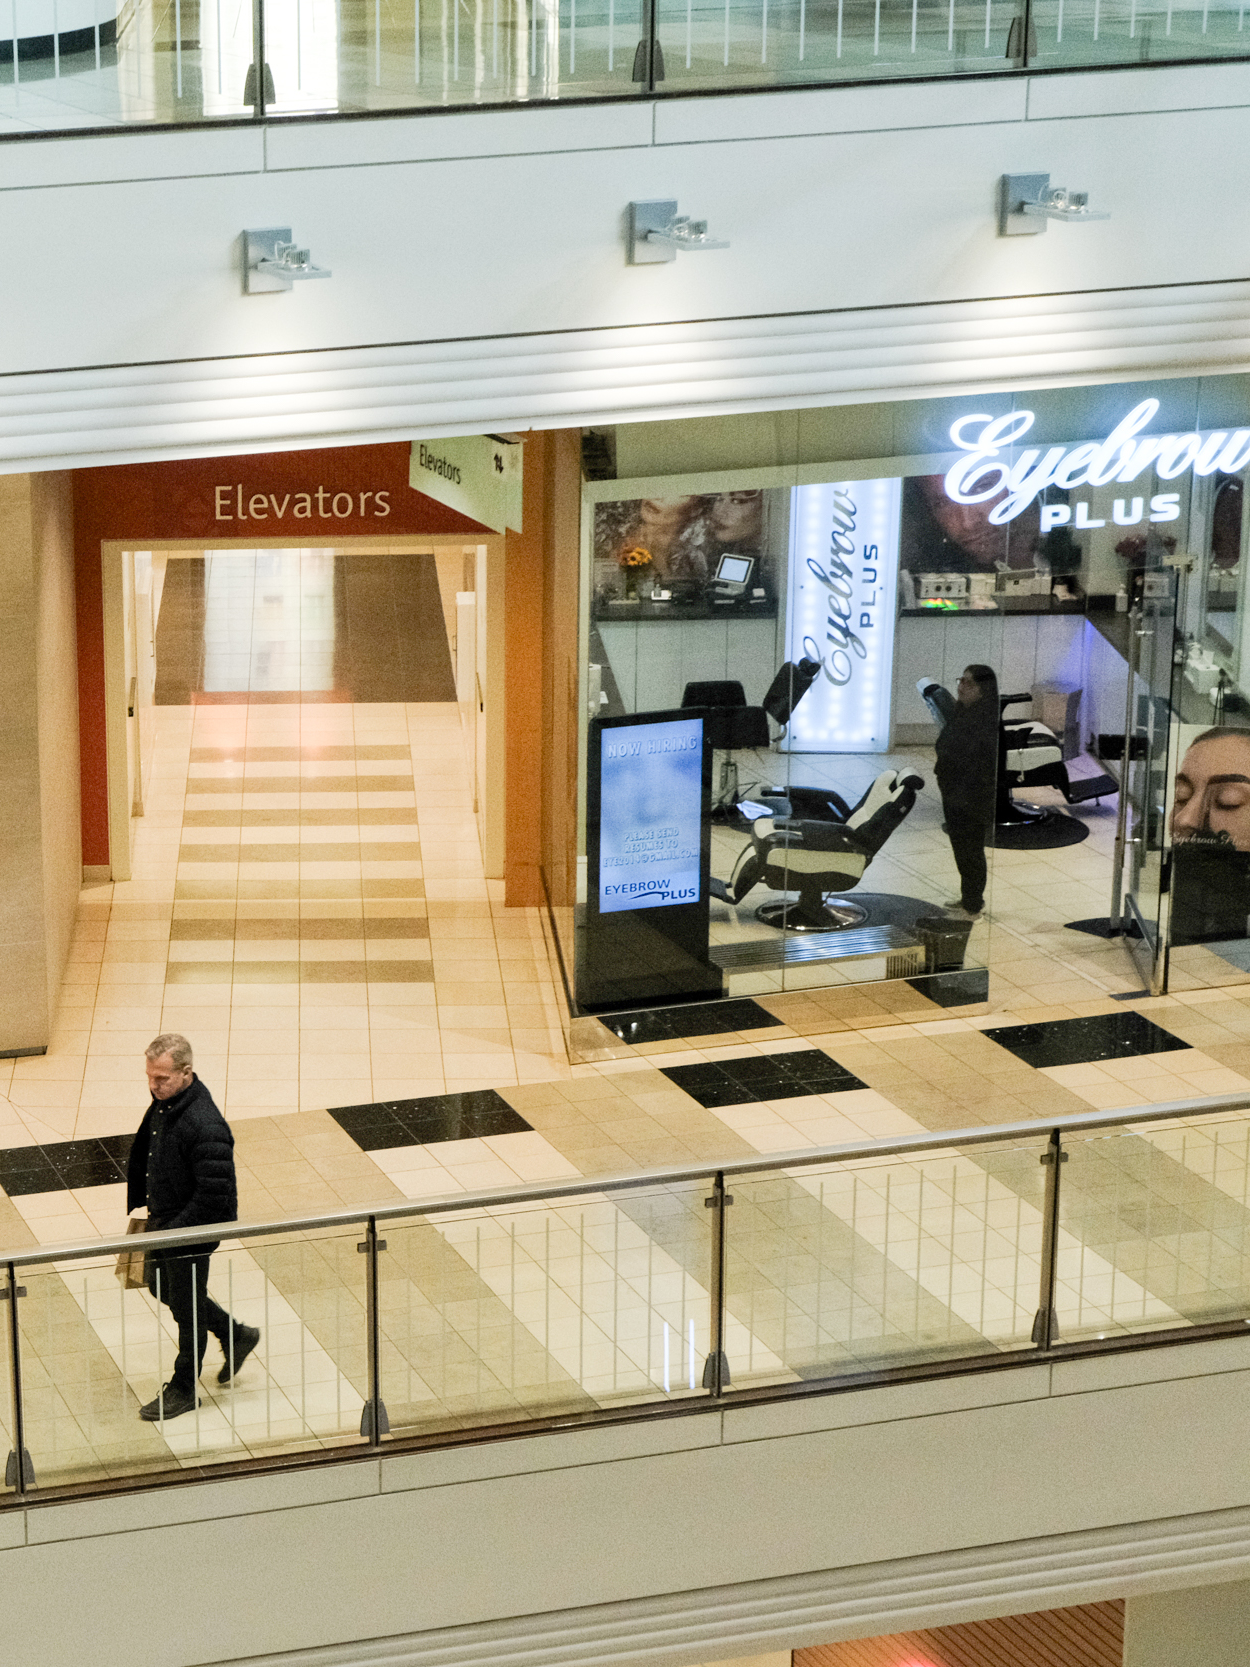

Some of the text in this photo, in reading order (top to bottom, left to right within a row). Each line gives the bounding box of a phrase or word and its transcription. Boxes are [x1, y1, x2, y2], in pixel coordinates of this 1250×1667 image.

[419, 444, 462, 485] Elevators
[214, 483, 391, 521] Elevators
[1040, 492, 1181, 533] PLUS
[803, 488, 868, 694] Eyebrow
[859, 544, 879, 628] PLUS
[608, 736, 697, 758] NOW HIRING
[624, 826, 680, 842] PLEASE SEND
[624, 838, 679, 854] RESUMES TO
[605, 878, 671, 896] EYEBROW
[661, 887, 696, 901] PLUS
